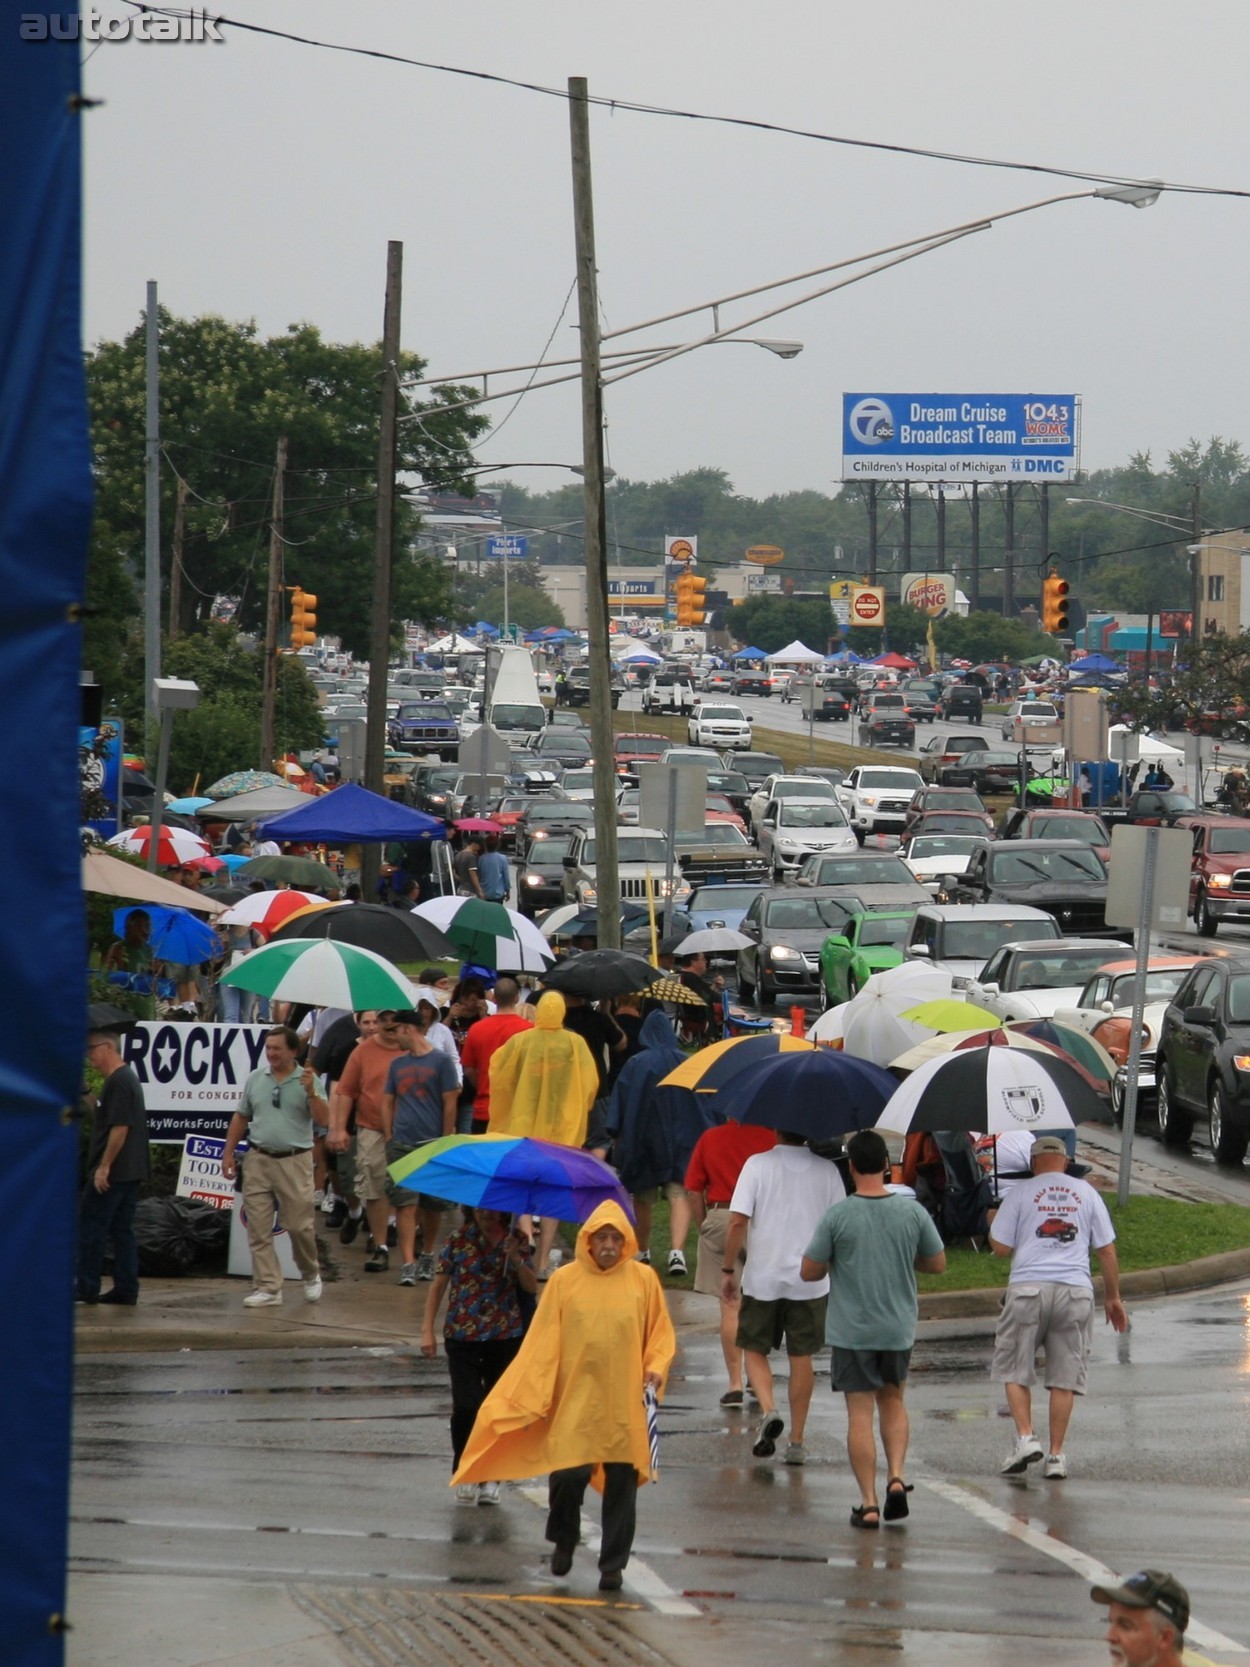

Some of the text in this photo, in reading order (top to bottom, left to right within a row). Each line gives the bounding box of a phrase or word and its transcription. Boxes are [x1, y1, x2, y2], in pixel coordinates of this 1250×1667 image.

[910, 402, 1007, 422] Dream Cruise
[1023, 403, 1068, 421] 104.3
[876, 426, 895, 436] abc
[900, 424, 1017, 444] Broadcast Team
[1026, 421, 1067, 436] WOMC
[853, 461, 1007, 475] Children's Hospital of Michigan
[1024, 459, 1065, 473] DMC
[909, 584, 945, 600] BURGER
[123, 1025, 270, 1085] ROCKY
[171, 1090, 193, 1100] FOR
[147, 1118, 229, 1130] kyWorksForUs
[188, 1159, 222, 1176] TOD
[182, 1176, 235, 1193] BY: EVERYT
[1034, 1188, 1047, 1204] HALF
[1048, 1186, 1070, 1194] MOON
[1057, 1205, 1078, 1213] STRIP
